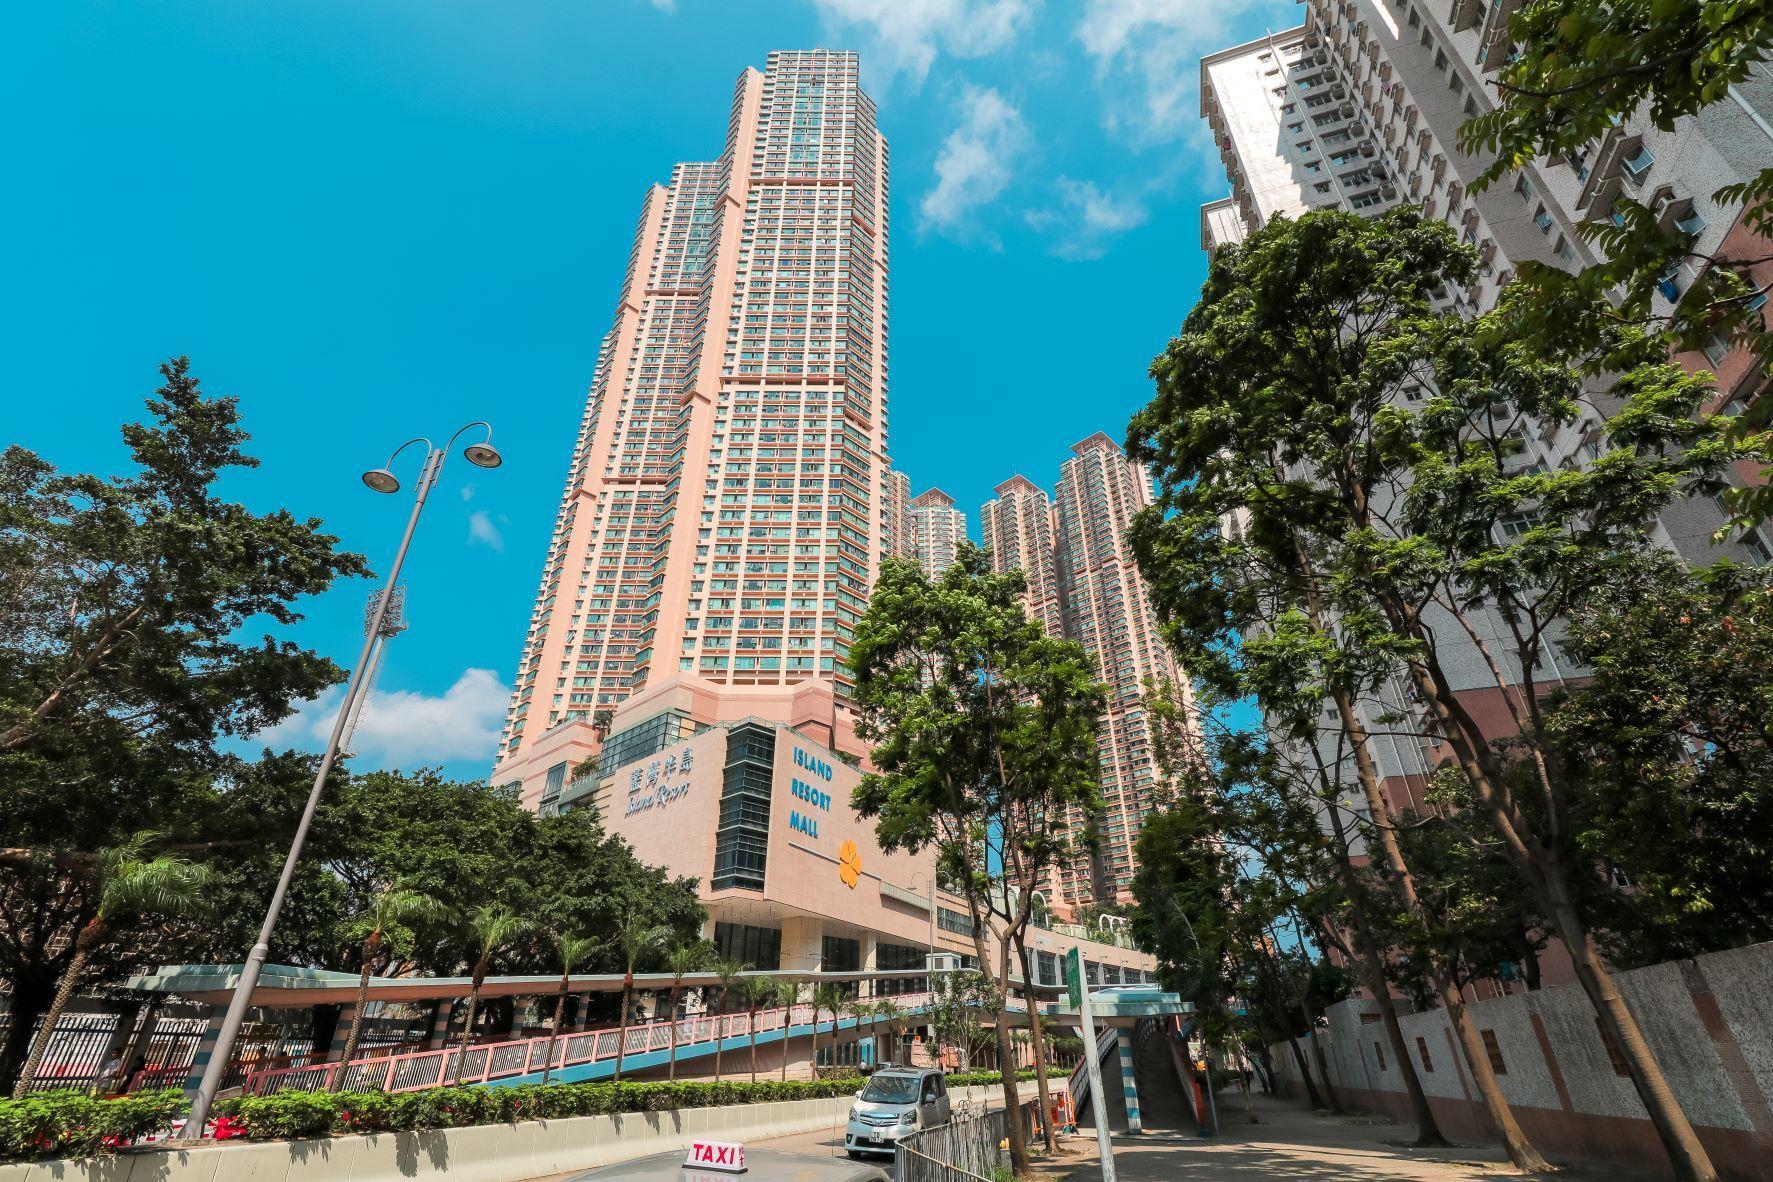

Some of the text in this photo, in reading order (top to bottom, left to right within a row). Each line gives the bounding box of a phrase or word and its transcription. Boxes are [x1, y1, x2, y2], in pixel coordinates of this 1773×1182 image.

[793, 746, 833, 782] ISLAND
[791, 777, 831, 812] RESORT
[789, 810, 818, 839] MALL
[693, 1143, 736, 1165] TAXI
